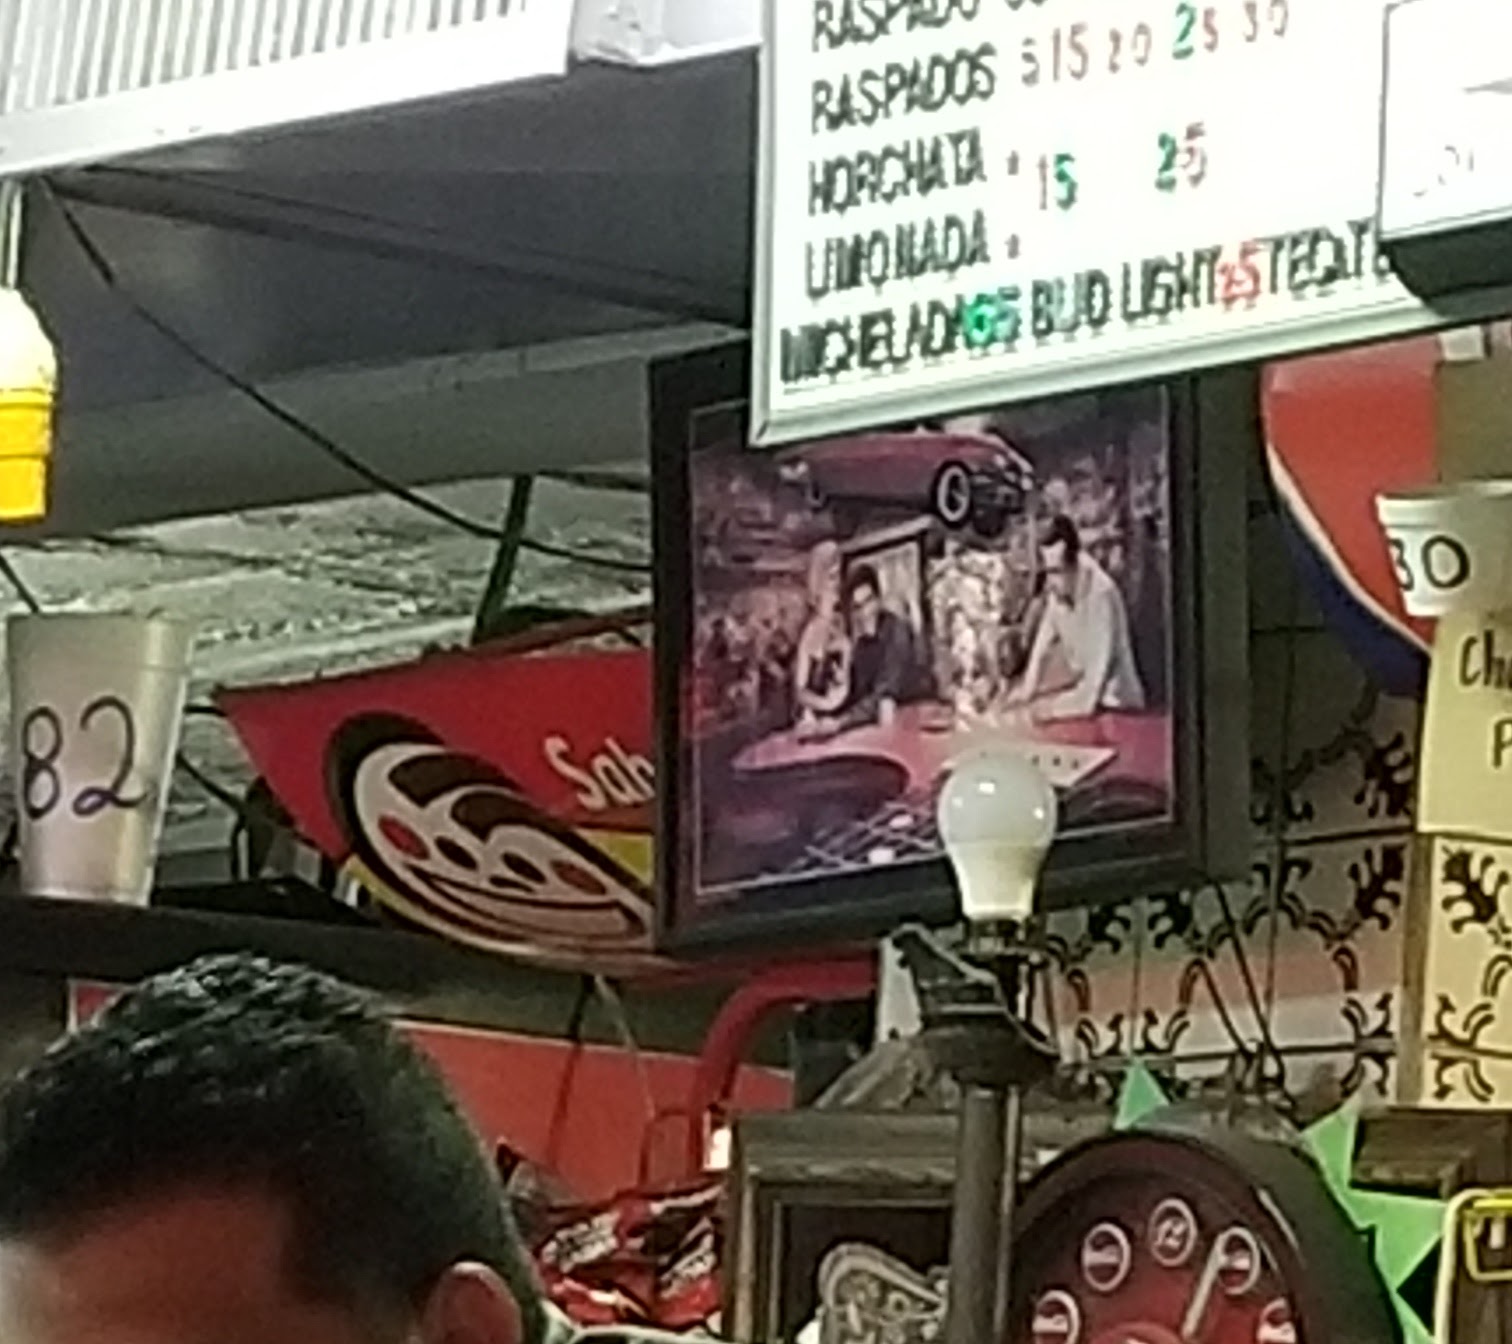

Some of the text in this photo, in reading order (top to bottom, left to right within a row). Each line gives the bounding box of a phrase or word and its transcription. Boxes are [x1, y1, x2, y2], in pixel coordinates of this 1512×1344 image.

[812, 42, 997, 135] RASPADOS
[808, 126, 987, 217] HORCHATA
[23, 695, 156, 821] 82
